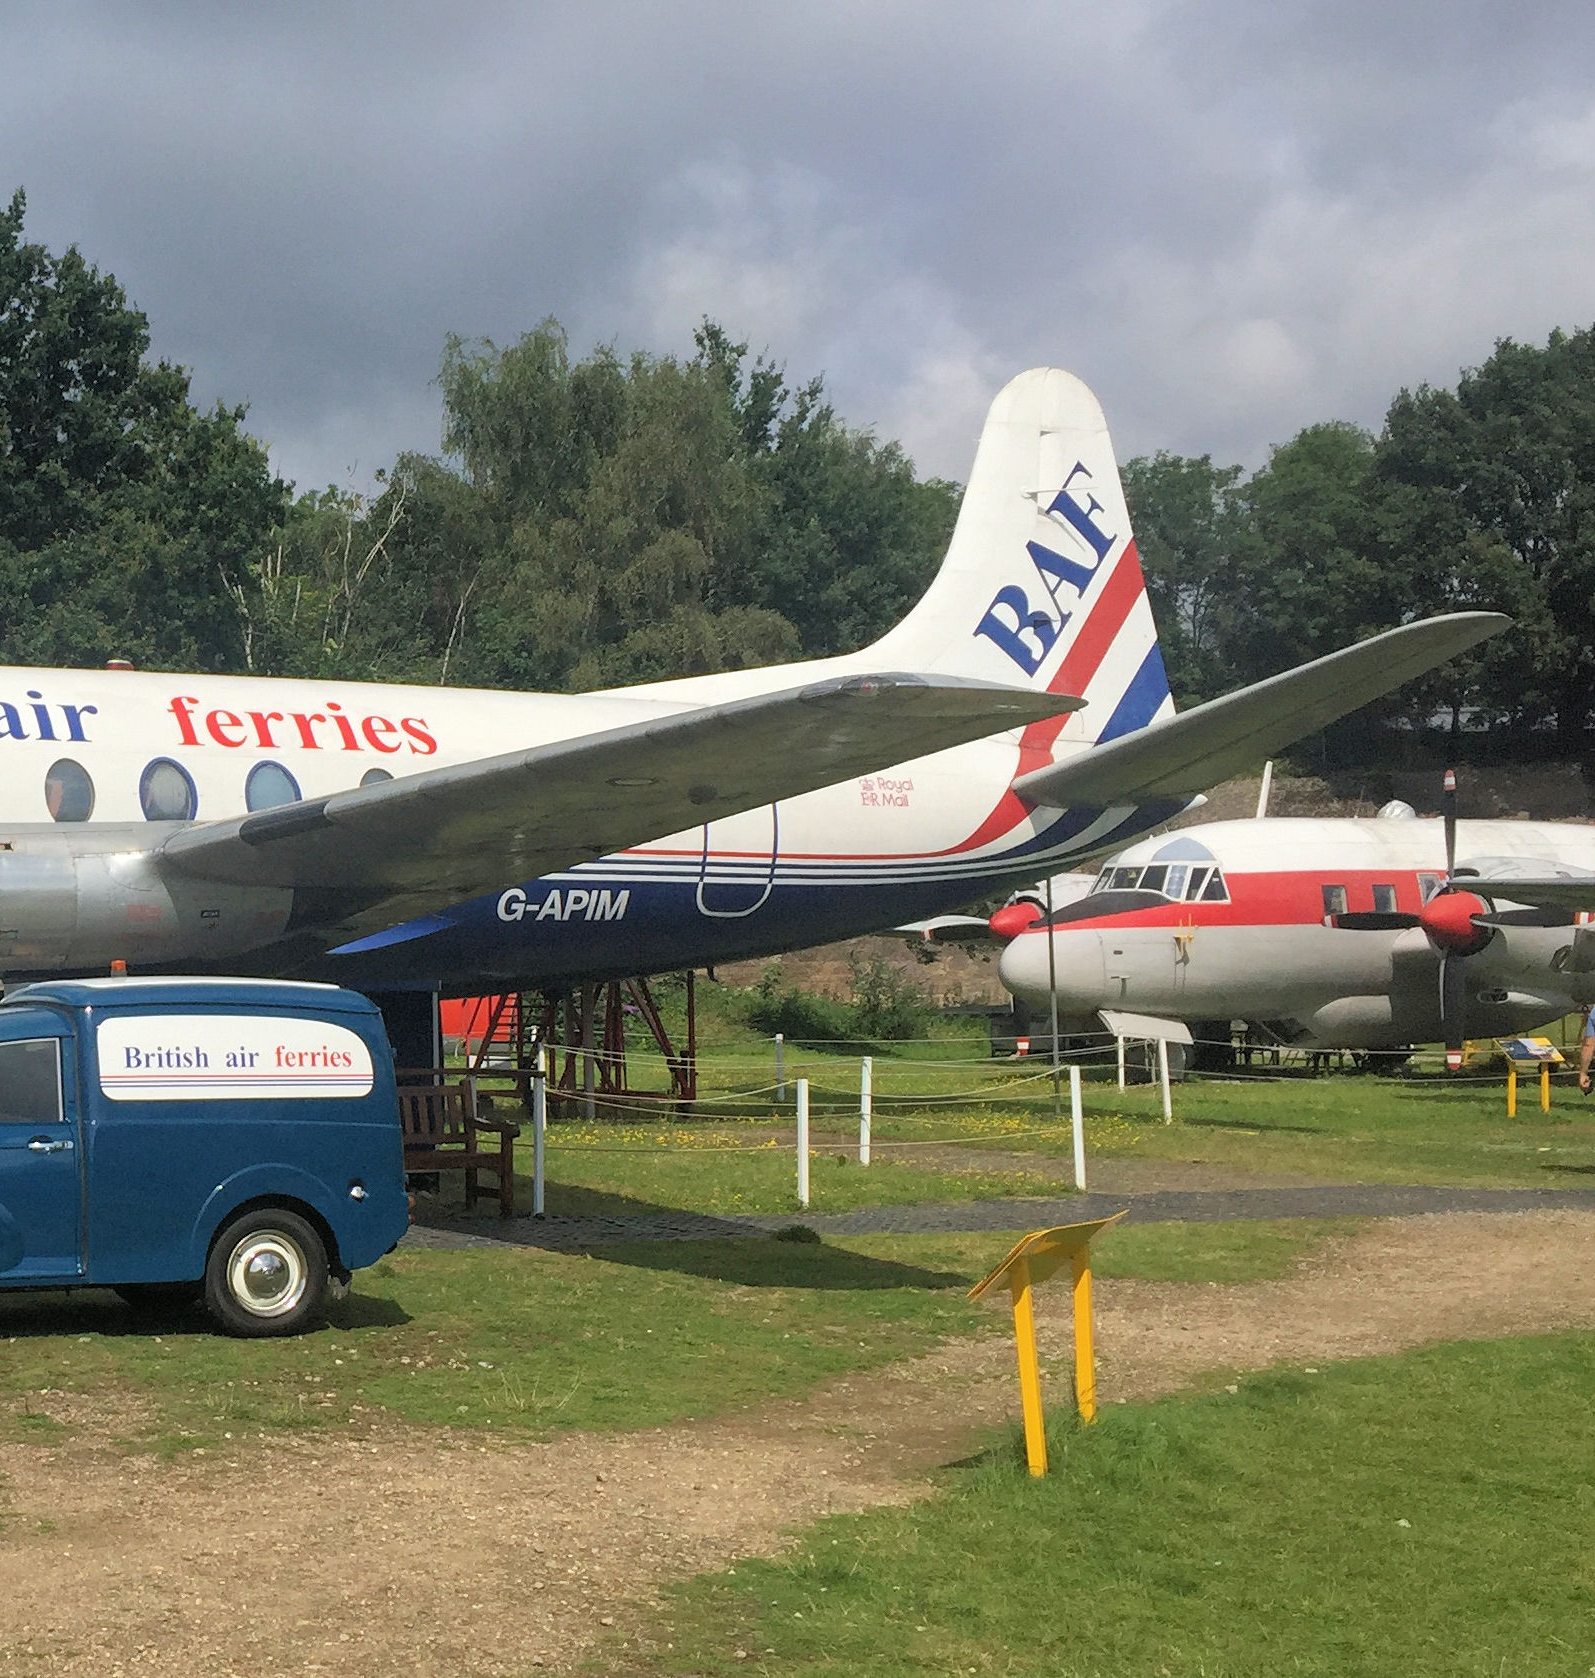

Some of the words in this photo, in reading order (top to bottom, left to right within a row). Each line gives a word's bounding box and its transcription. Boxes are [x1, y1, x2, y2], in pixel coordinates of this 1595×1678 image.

[972, 460, 1118, 678] BAF
[167, 696, 438, 755] ferries
[877, 777, 914, 793] Royal
[496, 888, 630, 921] G-APIM
[123, 1046, 209, 1068] British
[225, 1045, 260, 1067] air
[274, 1045, 353, 1067] ferries
